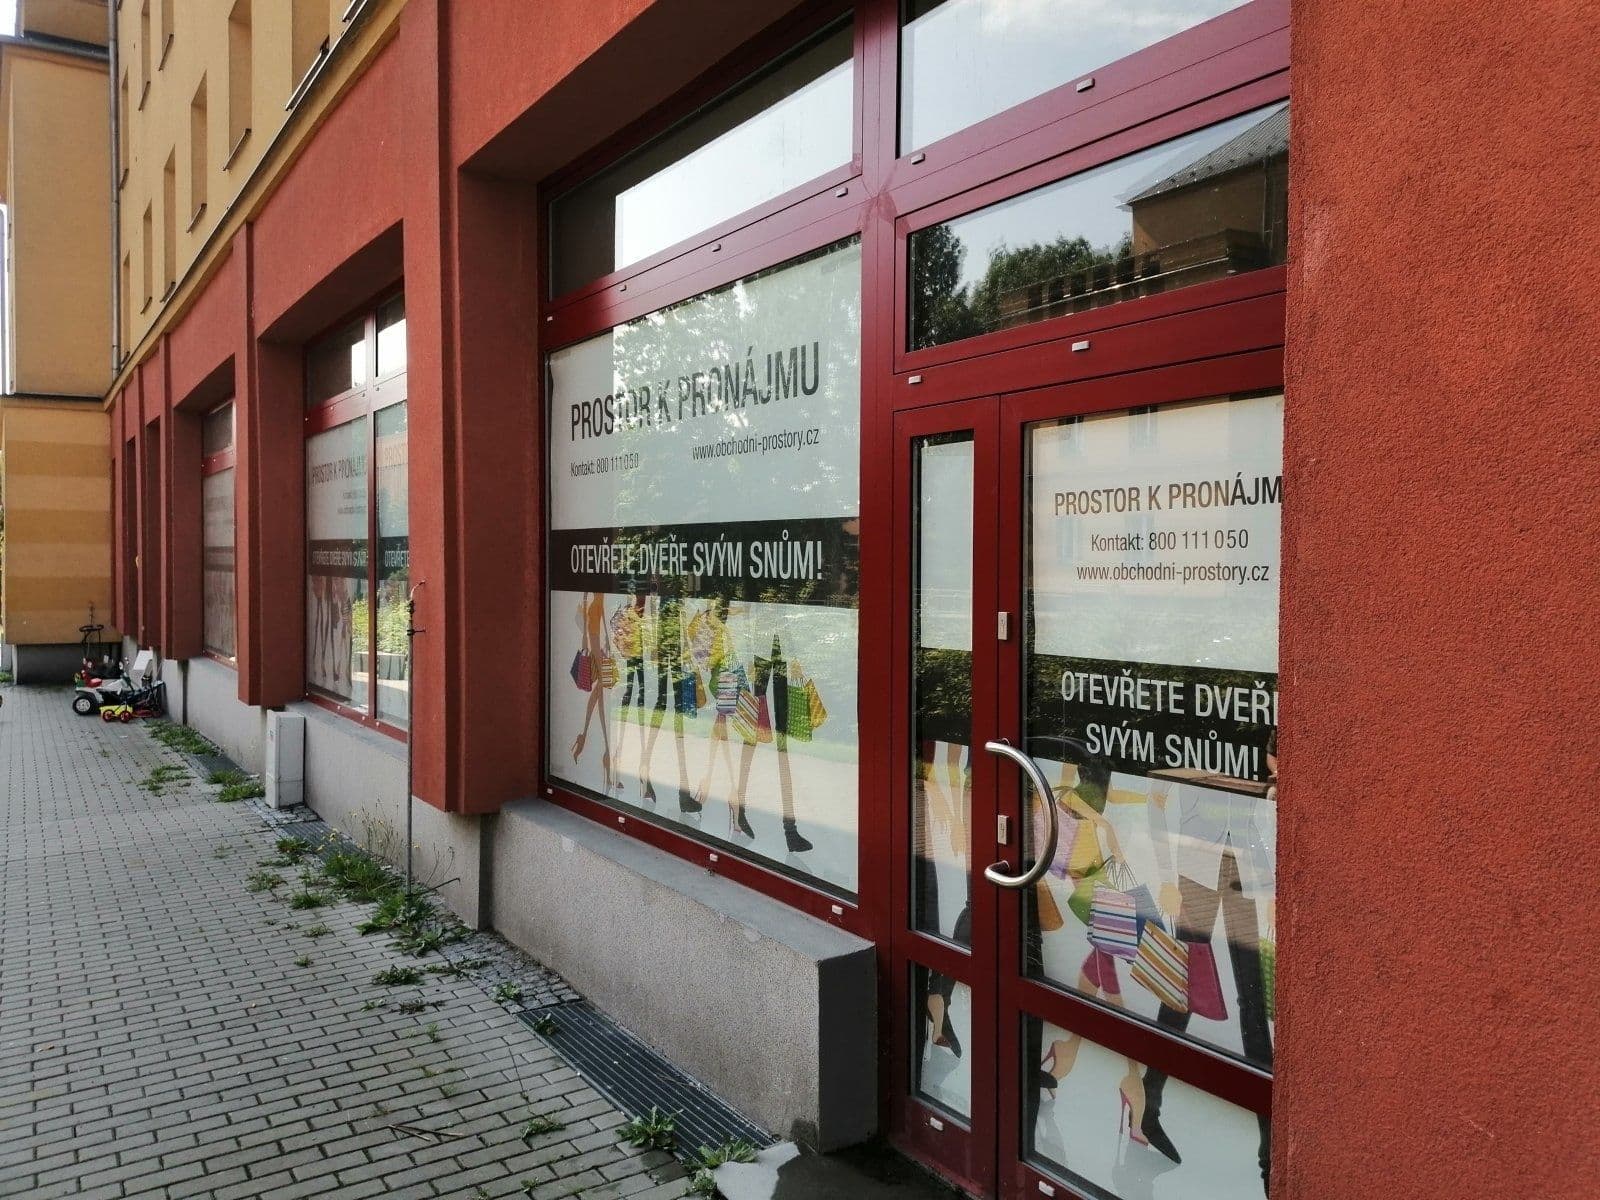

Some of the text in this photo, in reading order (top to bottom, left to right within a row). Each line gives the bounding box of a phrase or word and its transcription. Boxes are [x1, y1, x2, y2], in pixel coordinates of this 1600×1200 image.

[571, 342, 819, 441] PROSTOR K PRONÁJMU
[692, 426, 820, 460] www.obchodni-prostory.cz
[596, 457, 609, 474] 800
[1055, 486, 1141, 516] PROSTOR
[1148, 484, 1161, 511] K
[571, 529, 823, 580] OTEVŘETE DVEŘE SVÝM SNŮM!
[1091, 529, 1249, 552] Kontakt: 800 111 050
[1077, 562, 1270, 585] www.obchodni-prostory.cz
[1061, 668, 1184, 715] OTEVŘETE
[1086, 720, 1259, 781] SVÝM SNŮM!
